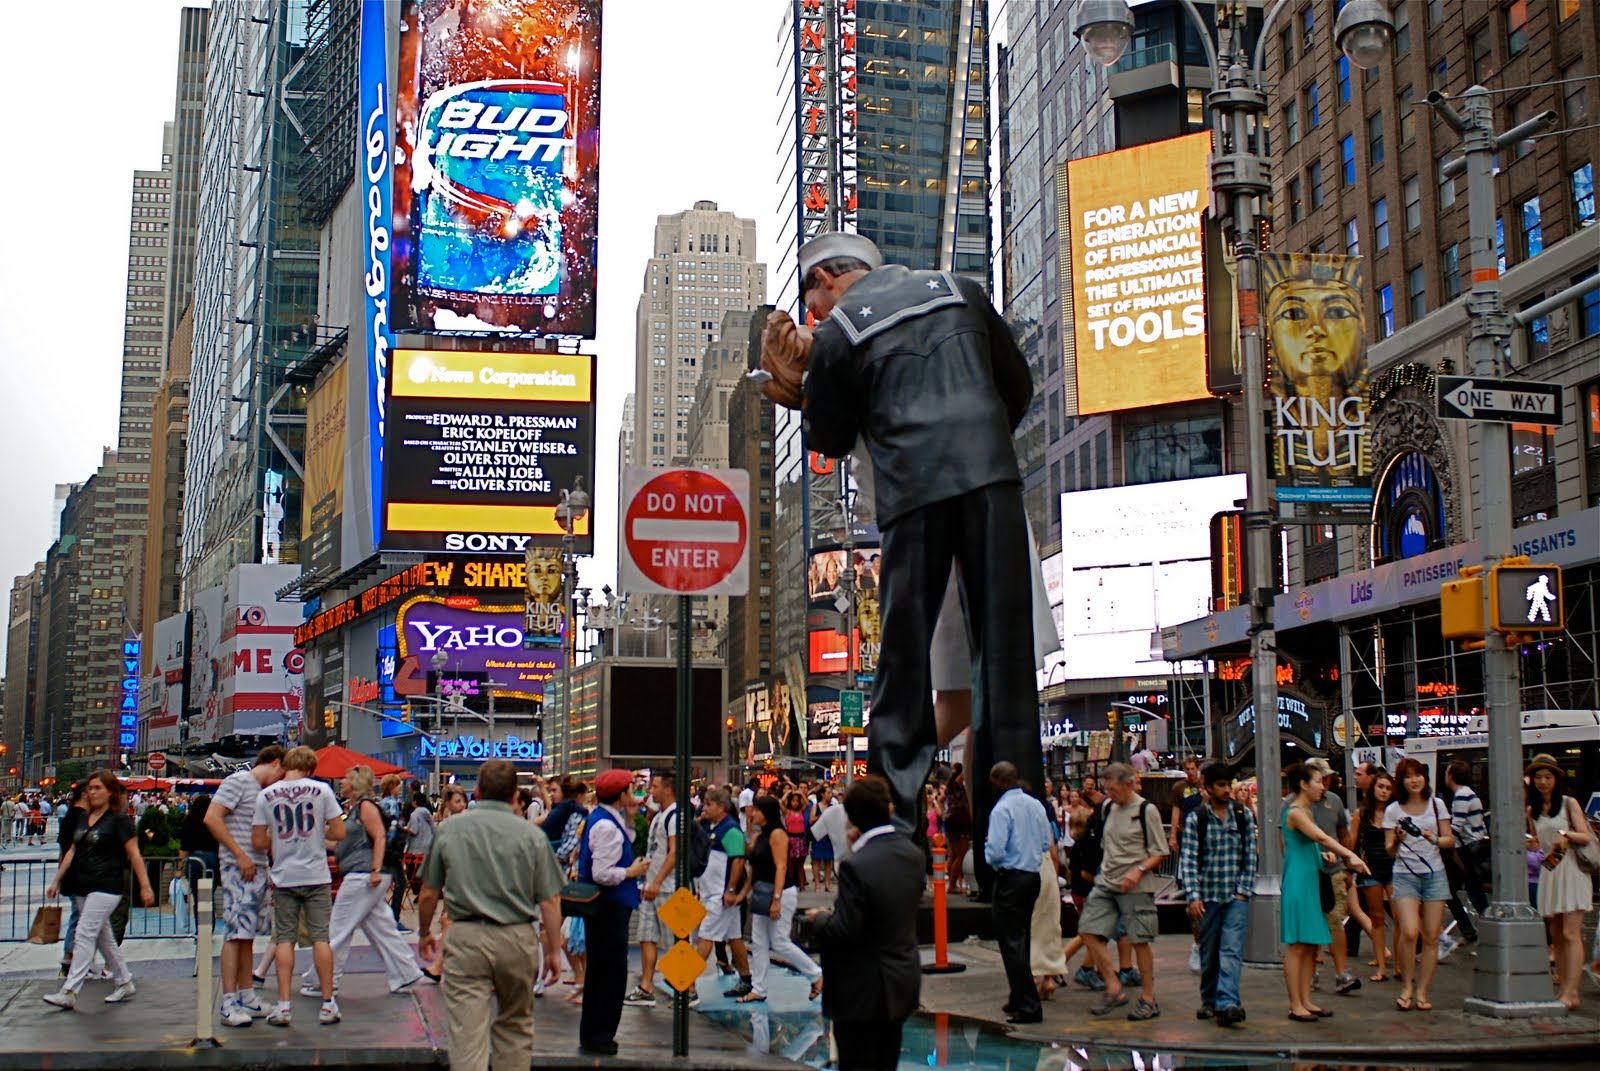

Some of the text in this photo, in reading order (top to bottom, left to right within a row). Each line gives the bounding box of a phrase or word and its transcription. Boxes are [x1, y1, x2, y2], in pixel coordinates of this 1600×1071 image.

[437, 98, 569, 134] BUD
[1084, 190, 1199, 229] FOR A NEW
[1084, 211, 1200, 248] GENERATION
[1085, 231, 1201, 266] OF FINANCIAL
[1085, 250, 1203, 284] PROFESSIONALS
[1085, 267, 1204, 302] THE ULTIMATE
[1087, 287, 1204, 319] SET OF FINANCIAL
[1087, 303, 1206, 351] TOOLS
[431, 364, 577, 389] News Corporation
[1275, 396, 1366, 428] KING
[1457, 390, 1548, 412] ONE WAY
[432, 413, 492, 427] EDWARD
[494, 415, 507, 427] R.
[509, 415, 577, 429] PRESSMAN
[442, 427, 542, 441] ERIC KOPELOFF
[461, 440, 577, 454] STANLEY WEISER &
[1276, 429, 1366, 467] TUT
[443, 453, 538, 466] OLIVER STONE
[462, 466, 507, 478] ALLAN
[510, 467, 543, 479] LOEB
[457, 480, 506, 491] OLIVER
[507, 480, 551, 492] STONE
[647, 492, 726, 514] DO NOT
[445, 534, 532, 551] SONY
[651, 547, 720, 570] ENTER
[1350, 582, 1373, 605] Lids
[525, 601, 561, 614] KING
[526, 614, 562, 630] TUT
[264, 785, 321, 801] ELWOOD
[272, 801, 315, 839] 96
